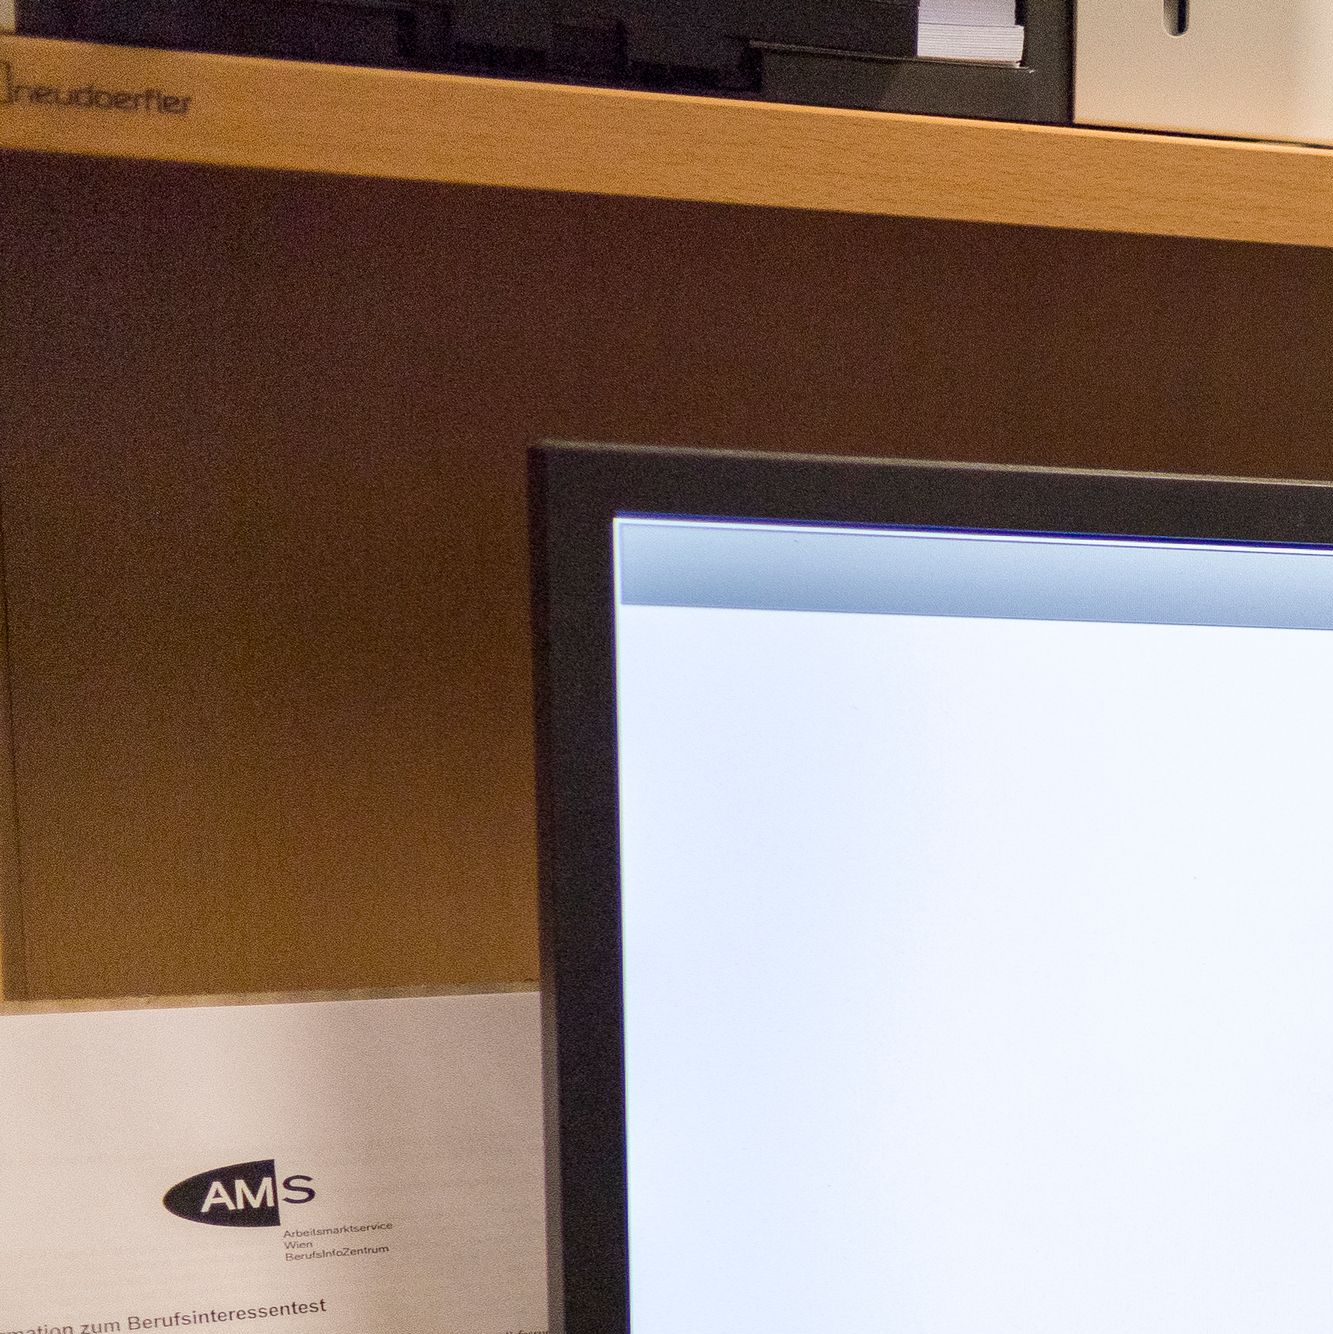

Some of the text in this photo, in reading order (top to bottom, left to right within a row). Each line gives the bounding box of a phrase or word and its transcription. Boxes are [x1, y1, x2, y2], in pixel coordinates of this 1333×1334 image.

[201, 1174, 316, 1213] AMS
[283, 1222, 393, 1238] Arbeitsmarktservice
[284, 1242, 313, 1250] Wien
[128, 1298, 327, 1331] Berufsinteressentest
